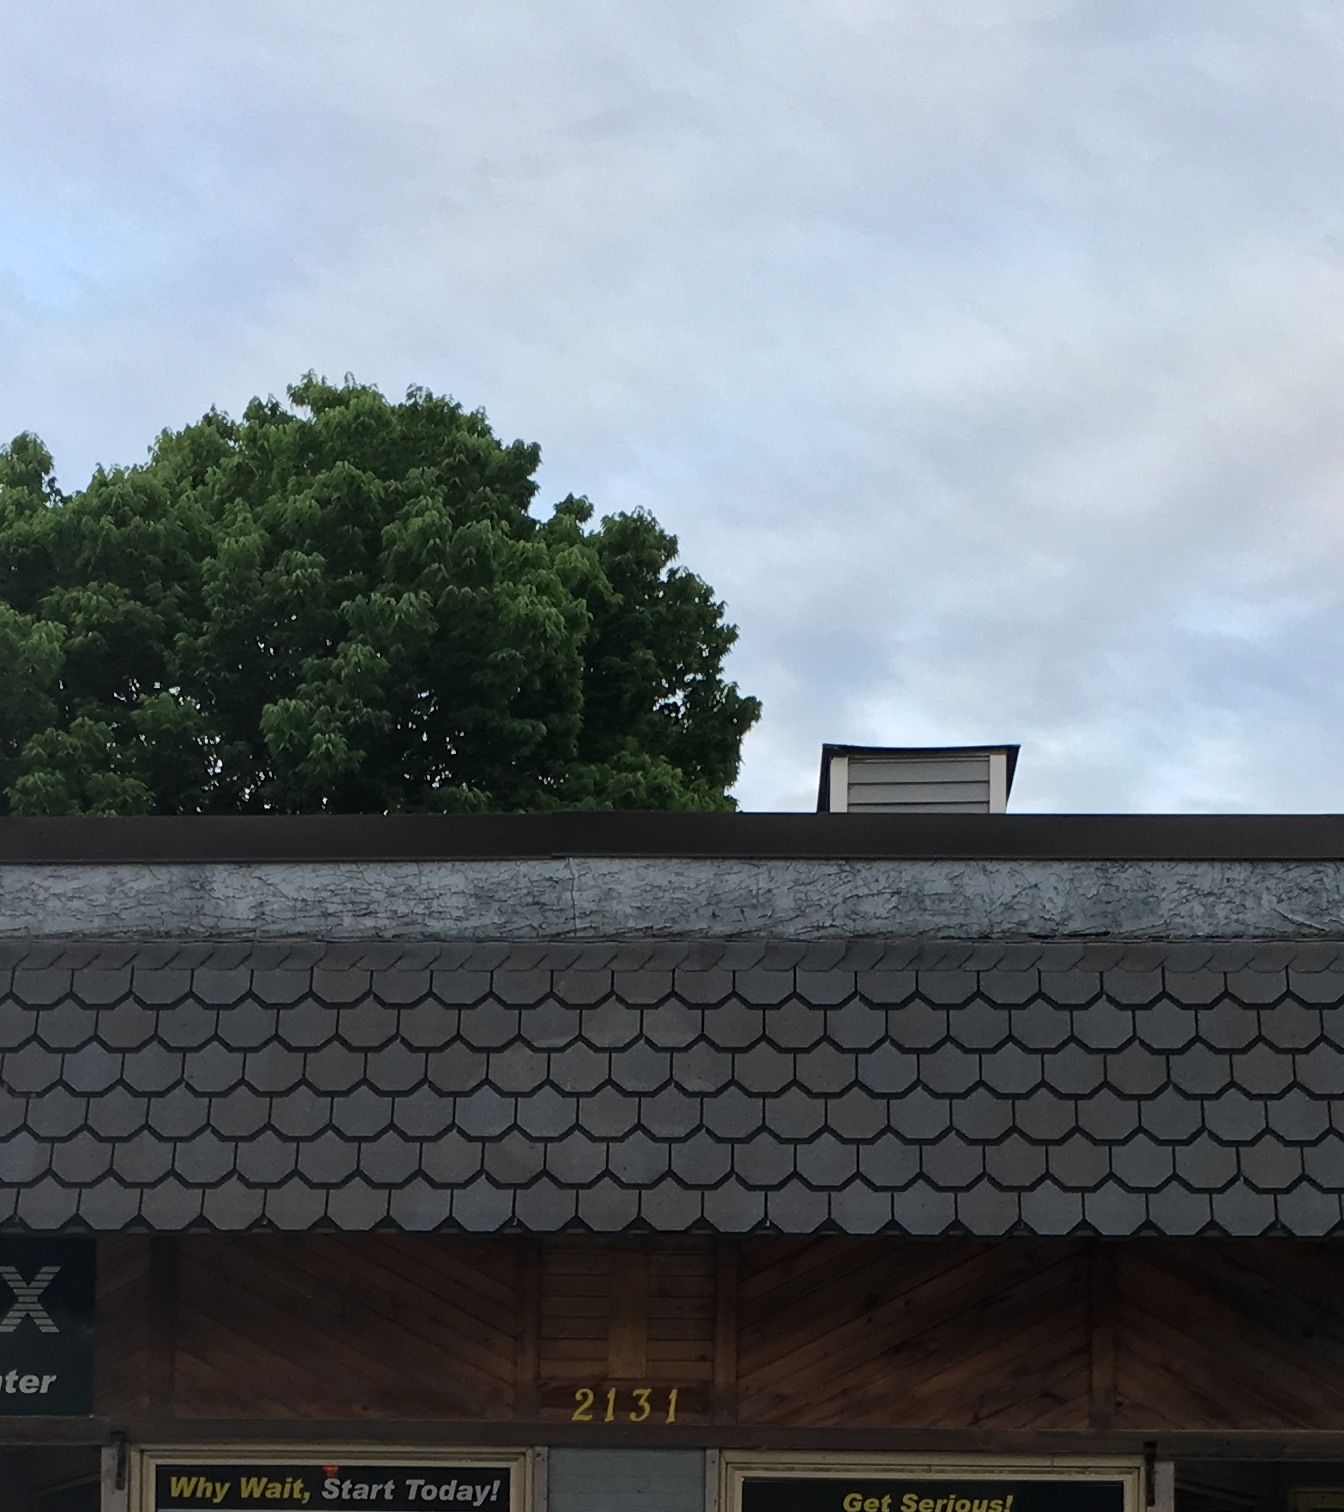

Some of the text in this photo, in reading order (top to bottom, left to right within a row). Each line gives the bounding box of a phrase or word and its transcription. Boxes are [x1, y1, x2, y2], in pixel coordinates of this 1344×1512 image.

[571, 1387, 678, 1424] 2131
[169, 1476, 501, 1507] Why Wait, Start Today!
[843, 1493, 893, 1512] Get
